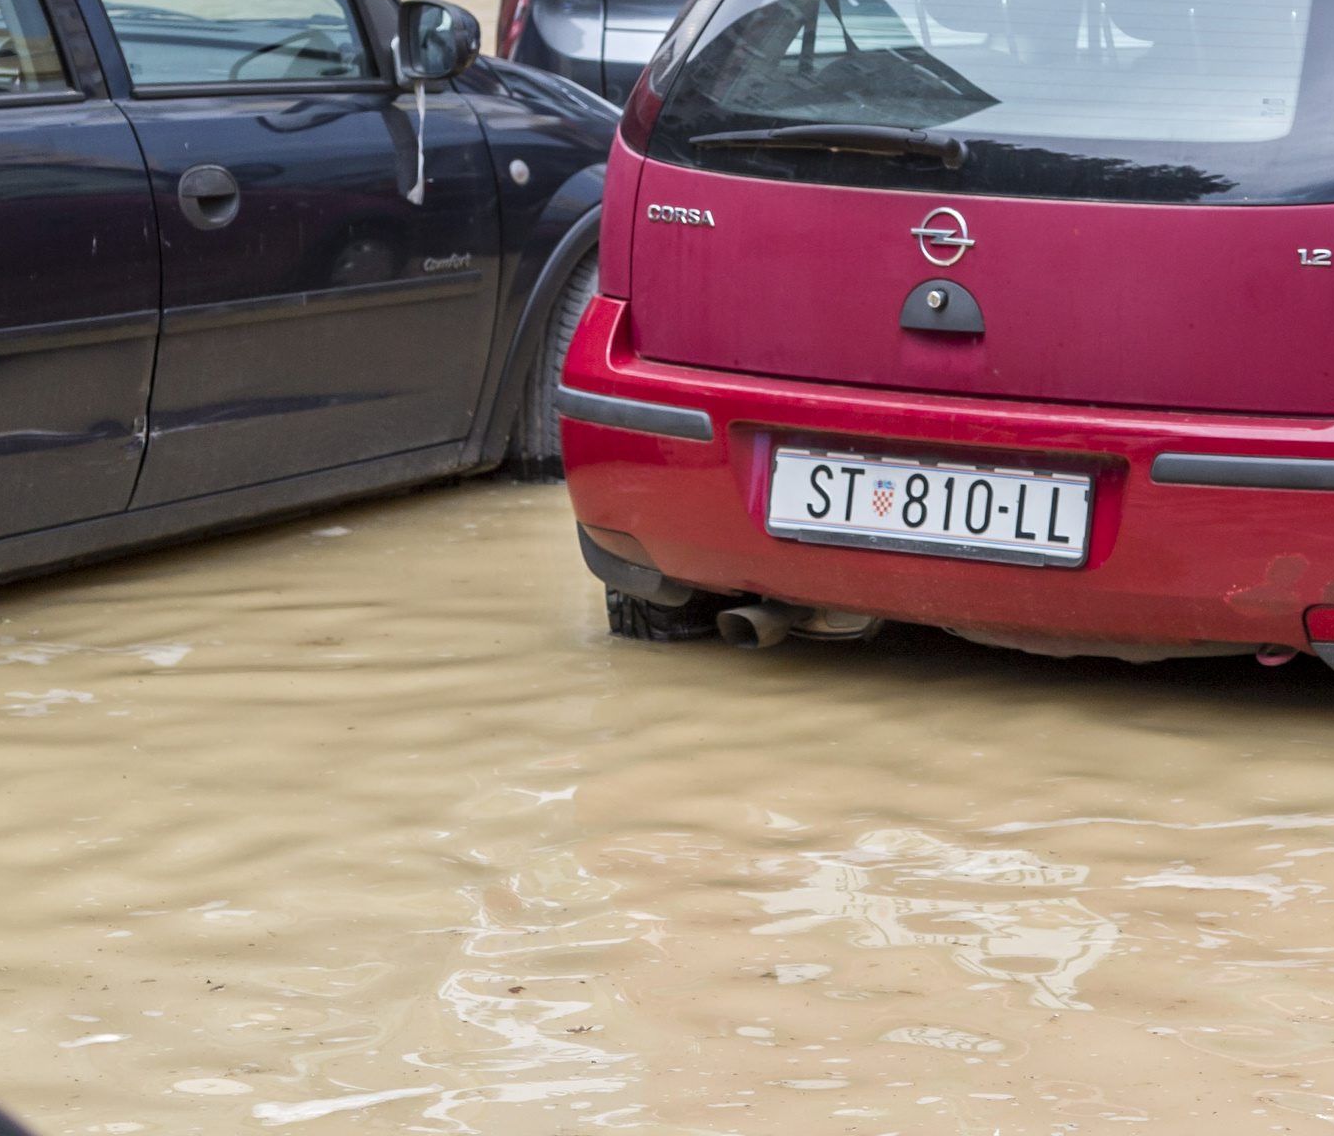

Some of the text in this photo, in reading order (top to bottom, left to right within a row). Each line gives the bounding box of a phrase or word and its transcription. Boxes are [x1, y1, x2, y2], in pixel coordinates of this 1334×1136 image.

[647, 204, 716, 227] CORSA
[1297, 248, 1332, 266] 1.2
[806, 464, 1070, 545] ST 810-LL
